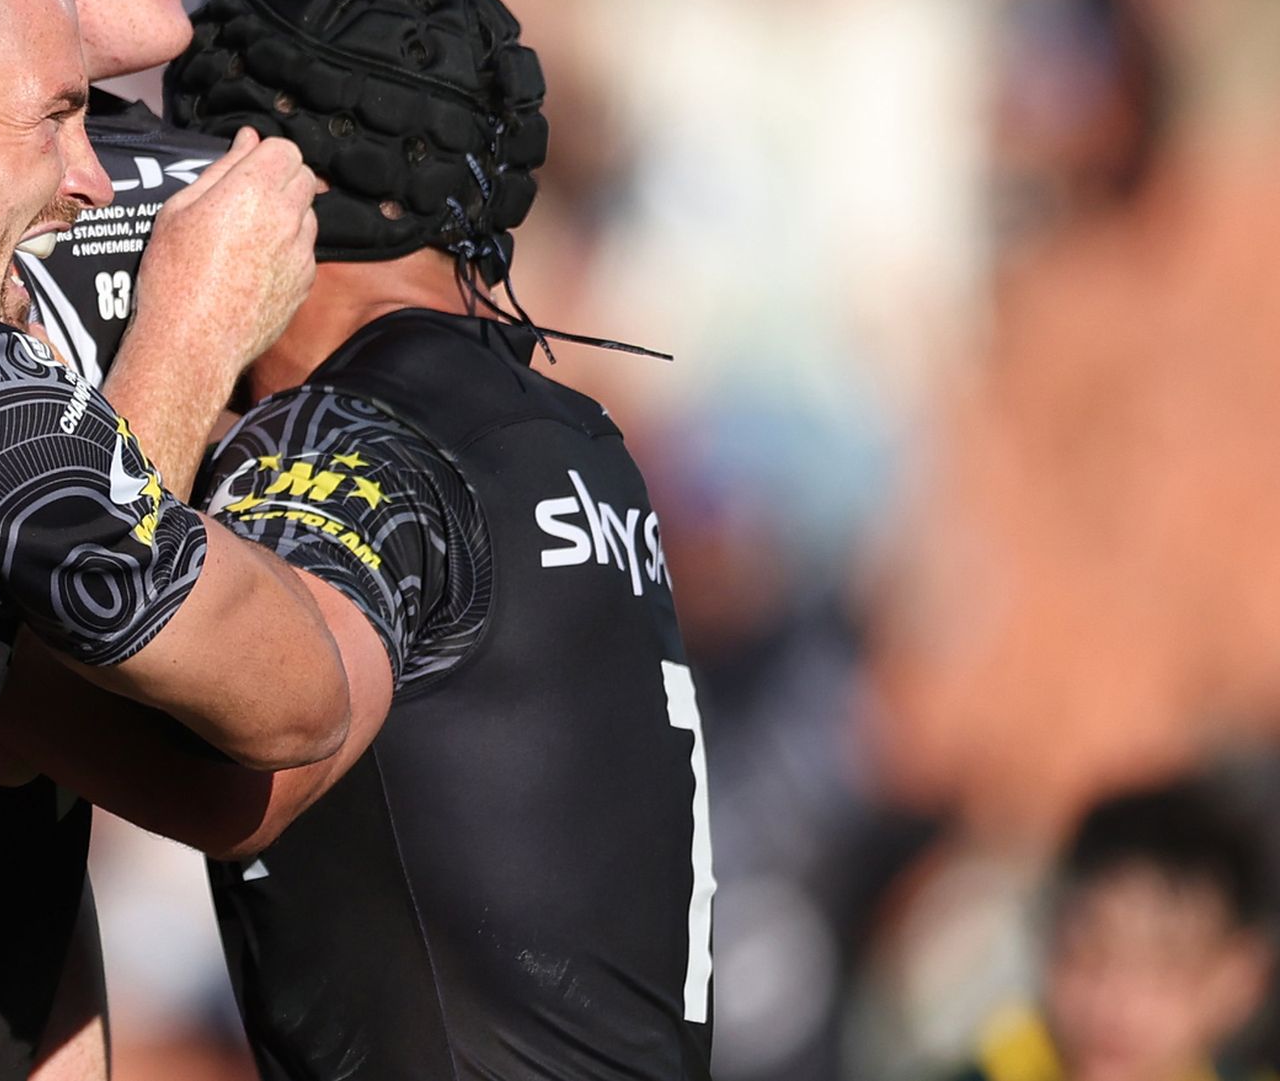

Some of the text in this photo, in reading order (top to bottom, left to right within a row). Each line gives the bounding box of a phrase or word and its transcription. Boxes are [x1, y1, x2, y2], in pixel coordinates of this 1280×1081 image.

[76, 205, 124, 222] ALAND
[72, 239, 143, 257] 4 NOVEMBER
[95, 270, 131, 320] 83
